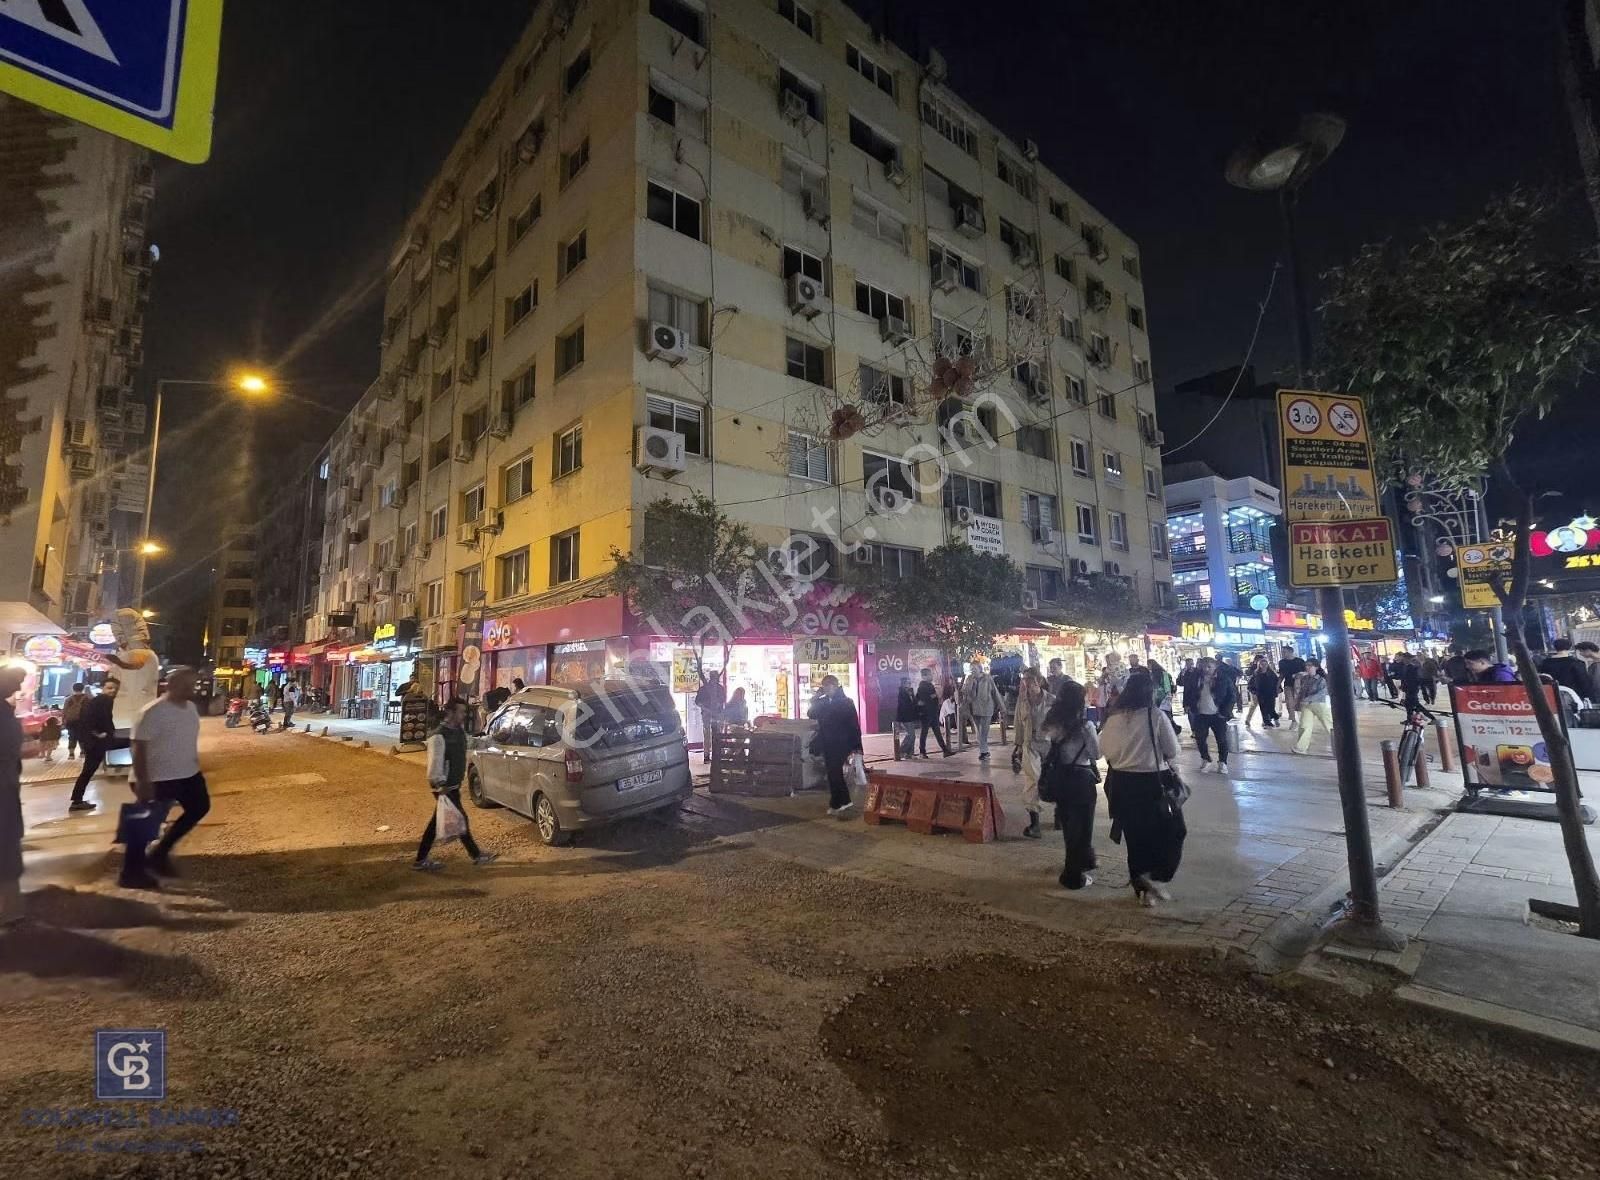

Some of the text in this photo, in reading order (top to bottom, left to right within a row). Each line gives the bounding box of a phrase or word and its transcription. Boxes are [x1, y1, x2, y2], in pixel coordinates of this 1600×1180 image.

[1289, 499, 1376, 513] Hareketli Bariyer
[1299, 543, 1385, 560] Hareketli
[1306, 562, 1379, 579] Bariyer
[802, 609, 849, 635] eve
[487, 621, 513, 647] eve
[811, 639, 829, 660] 75
[878, 654, 903, 671] eve
[1467, 700, 1533, 711] Getmob
[1471, 725, 1486, 735] 12
[1509, 726, 1523, 736] 12
